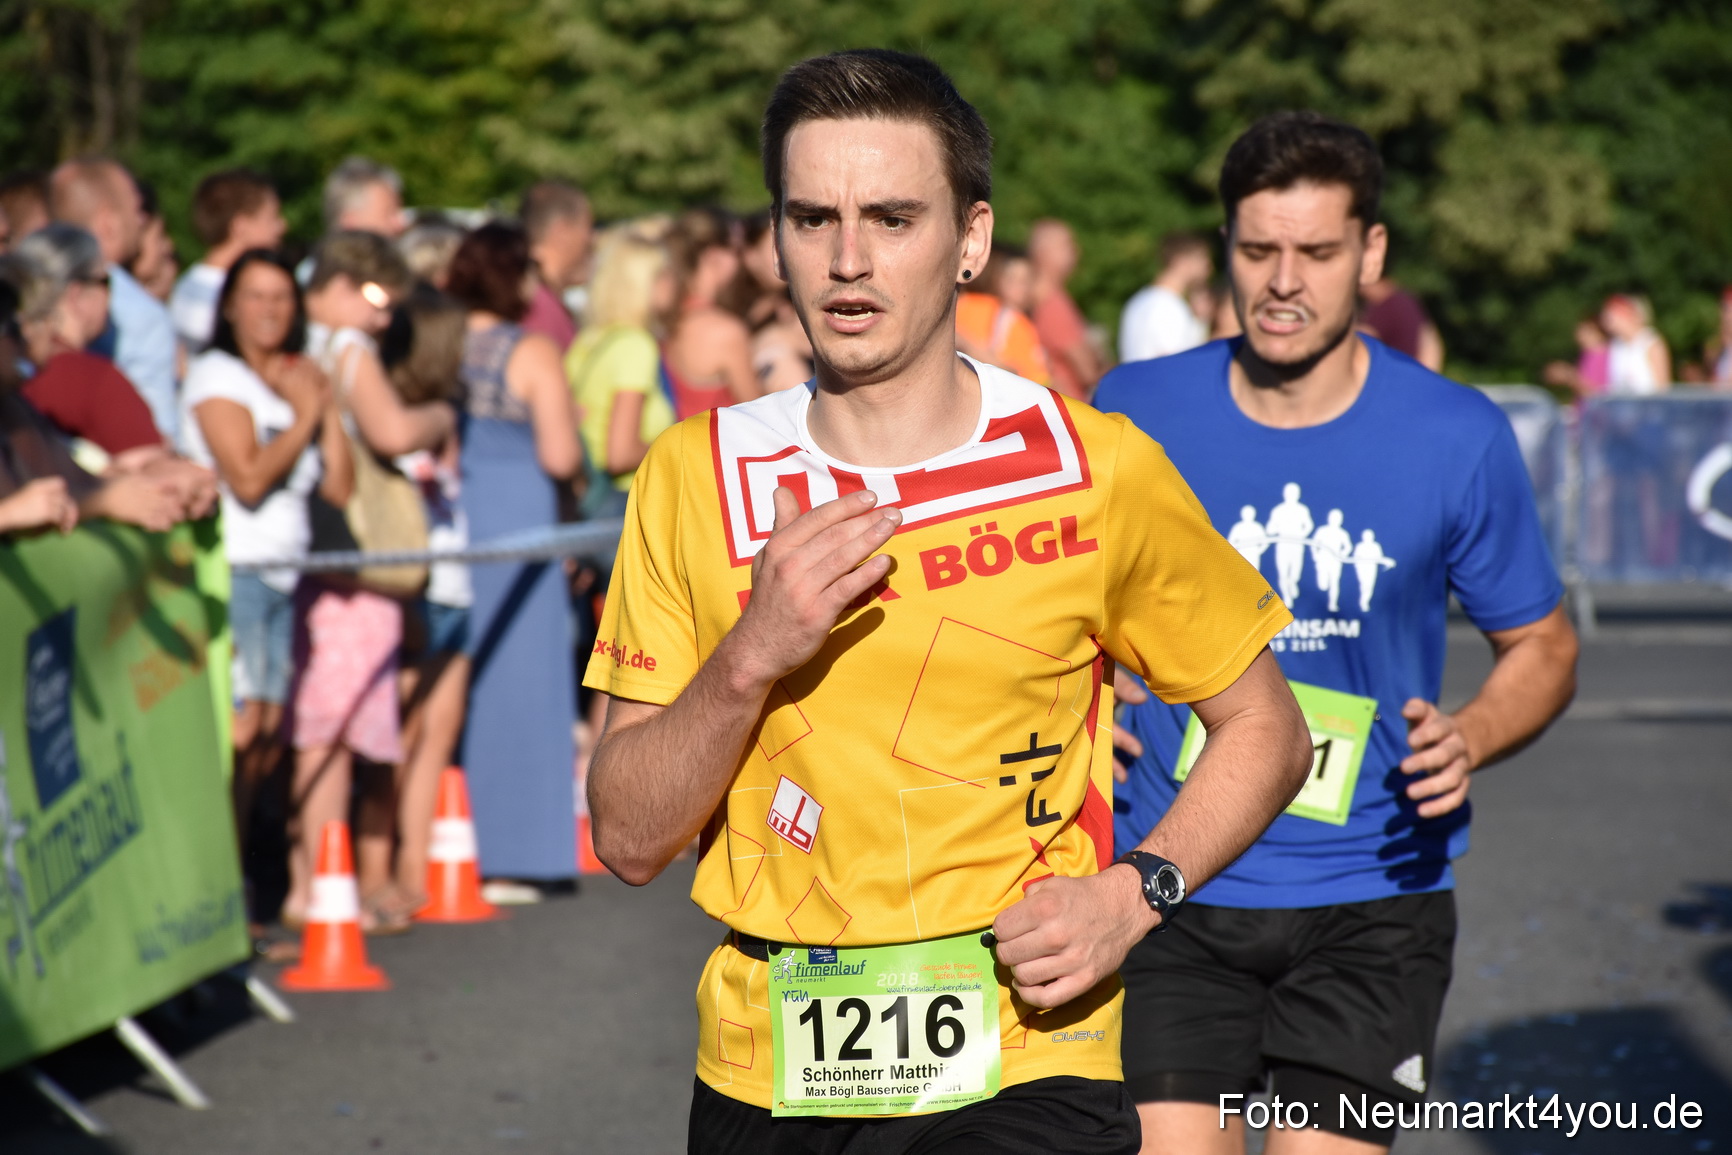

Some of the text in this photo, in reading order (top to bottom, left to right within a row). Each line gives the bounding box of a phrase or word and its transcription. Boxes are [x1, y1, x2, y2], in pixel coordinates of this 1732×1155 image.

[919, 514, 1099, 592] BÖGL
[1291, 638, 1327, 652] ZIEL
[796, 960, 867, 977] firmenlauf
[877, 972, 919, 986] 2018
[799, 994, 966, 1062] 1216
[802, 1062, 957, 1082] Schönherr Matthi
[805, 1085, 826, 1097] Max
[829, 1085, 854, 1098] Bögl
[857, 1083, 919, 1096] Bauservice
